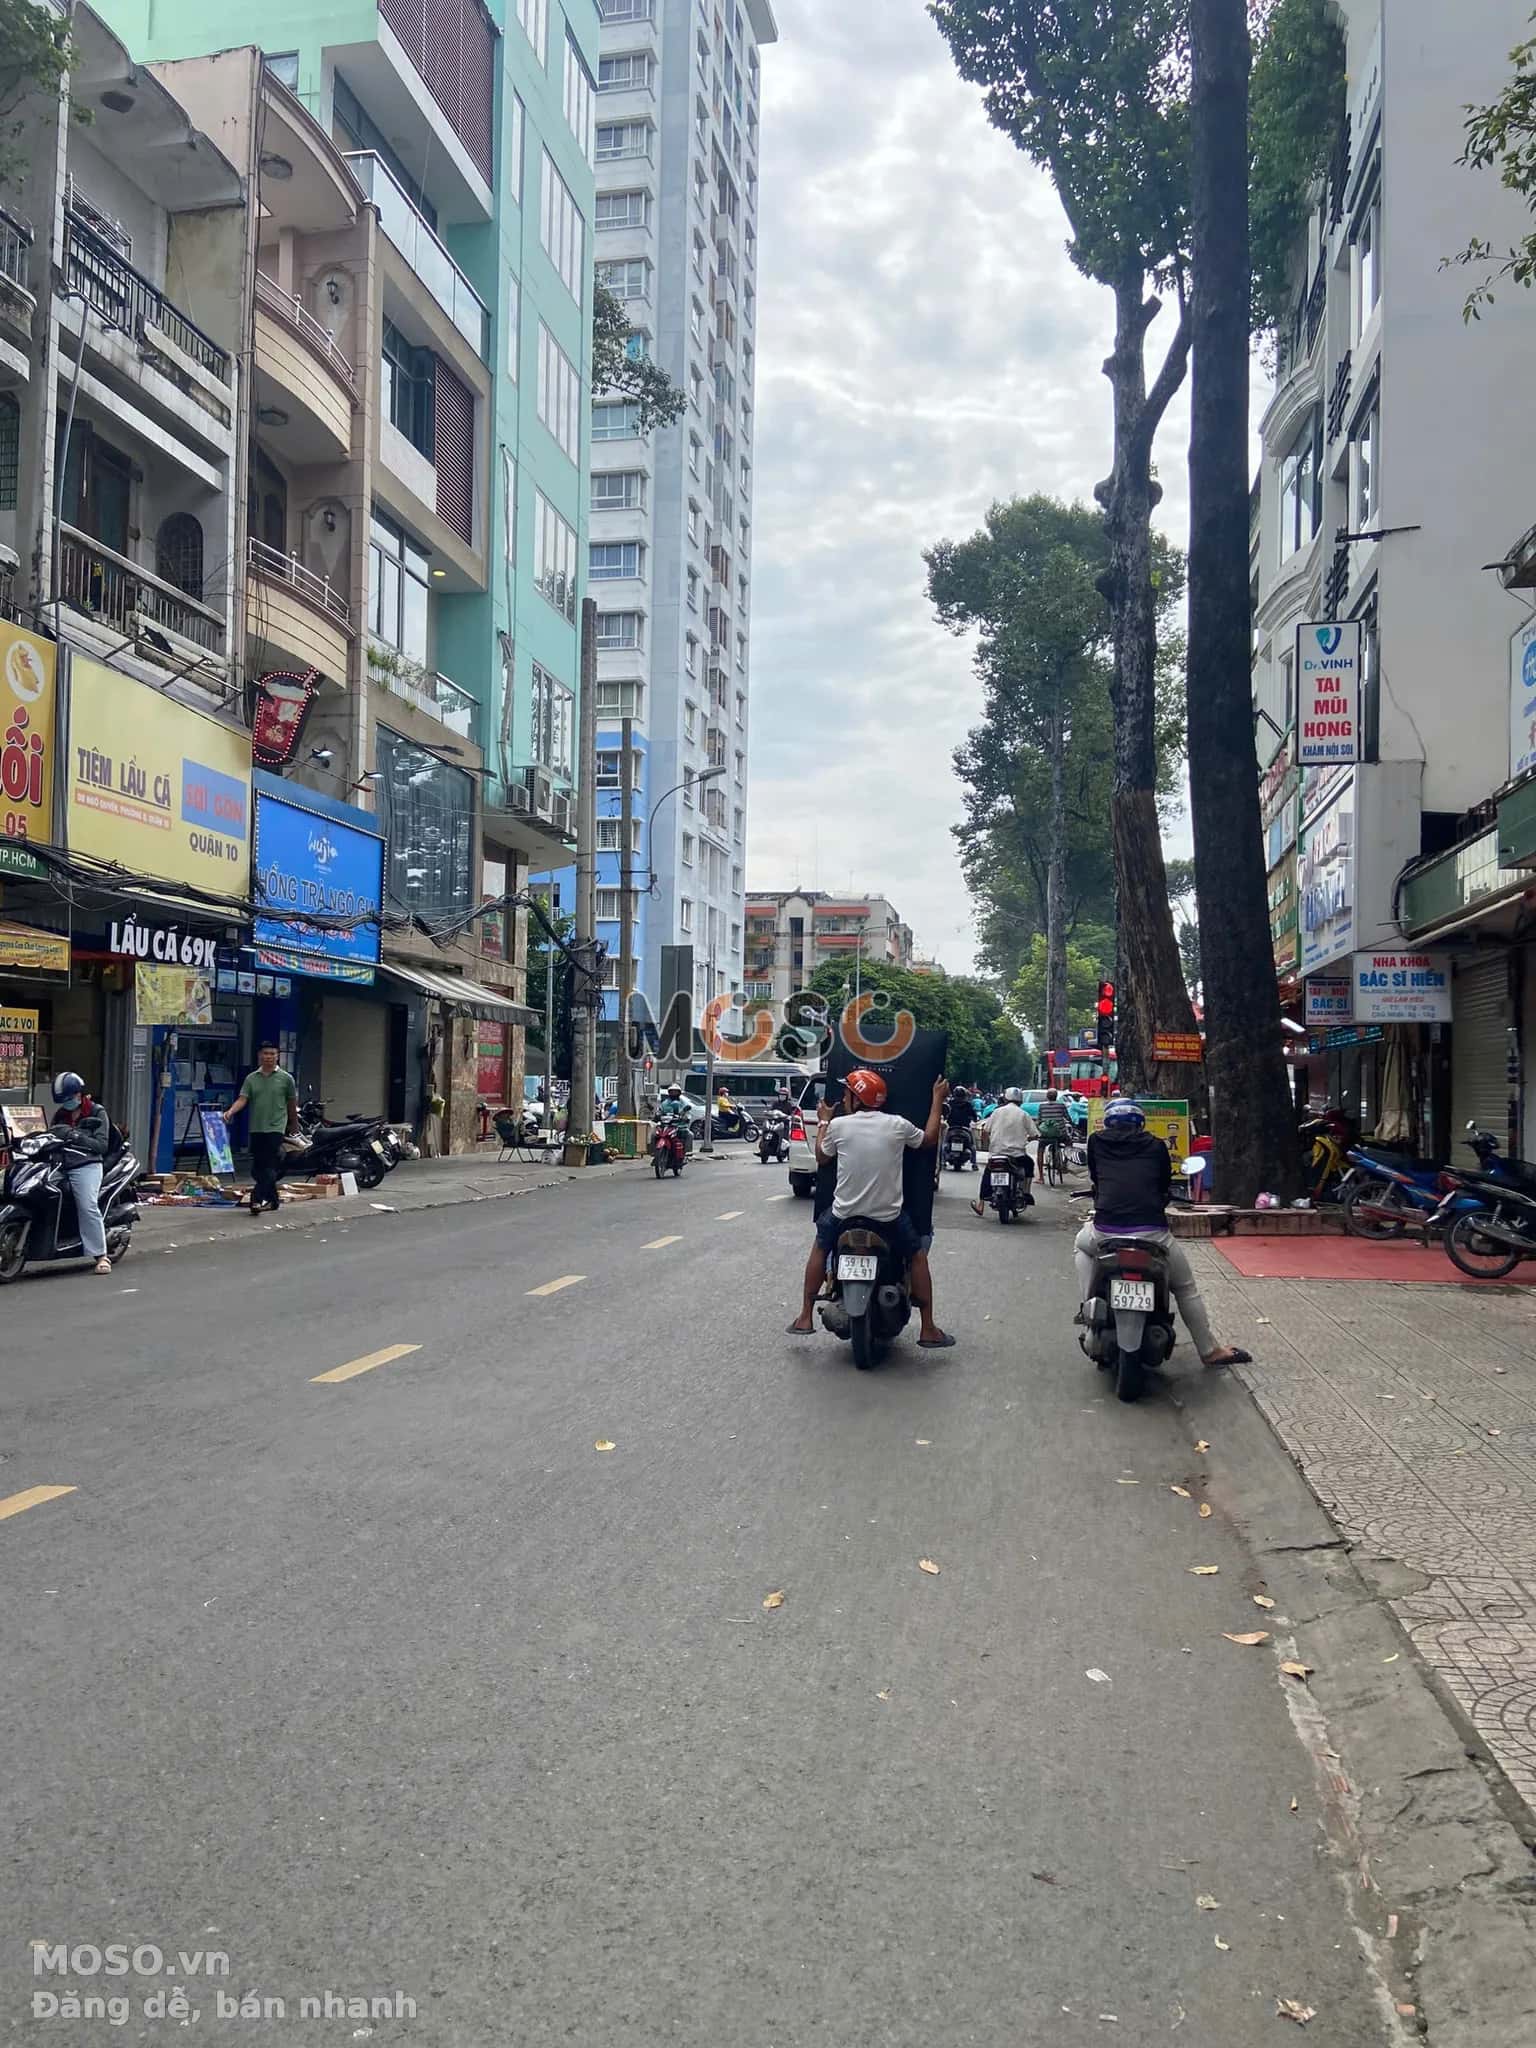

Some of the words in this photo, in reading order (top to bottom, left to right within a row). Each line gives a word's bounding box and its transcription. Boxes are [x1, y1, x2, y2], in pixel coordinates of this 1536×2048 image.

[1304, 658, 1353, 671] Dr.VINH
[1315, 677, 1341, 693] TAI
[1314, 696, 1348, 715] MŨI
[1303, 721, 1352, 741] HỌNG
[153, 773, 171, 808] CÁ
[189, 832, 223, 858] QUẬN
[225, 843, 238, 862] 10
[300, 879, 326, 909] TRÀ
[110, 913, 149, 957] LẨU
[152, 925, 178, 962] CÁ
[180, 935, 217, 967] 69K
[1373, 956, 1397, 968] NHA
[1400, 956, 1431, 968] KHOA
[1359, 970, 1389, 987] BÁC
[1392, 970, 1407, 987] SĨ
